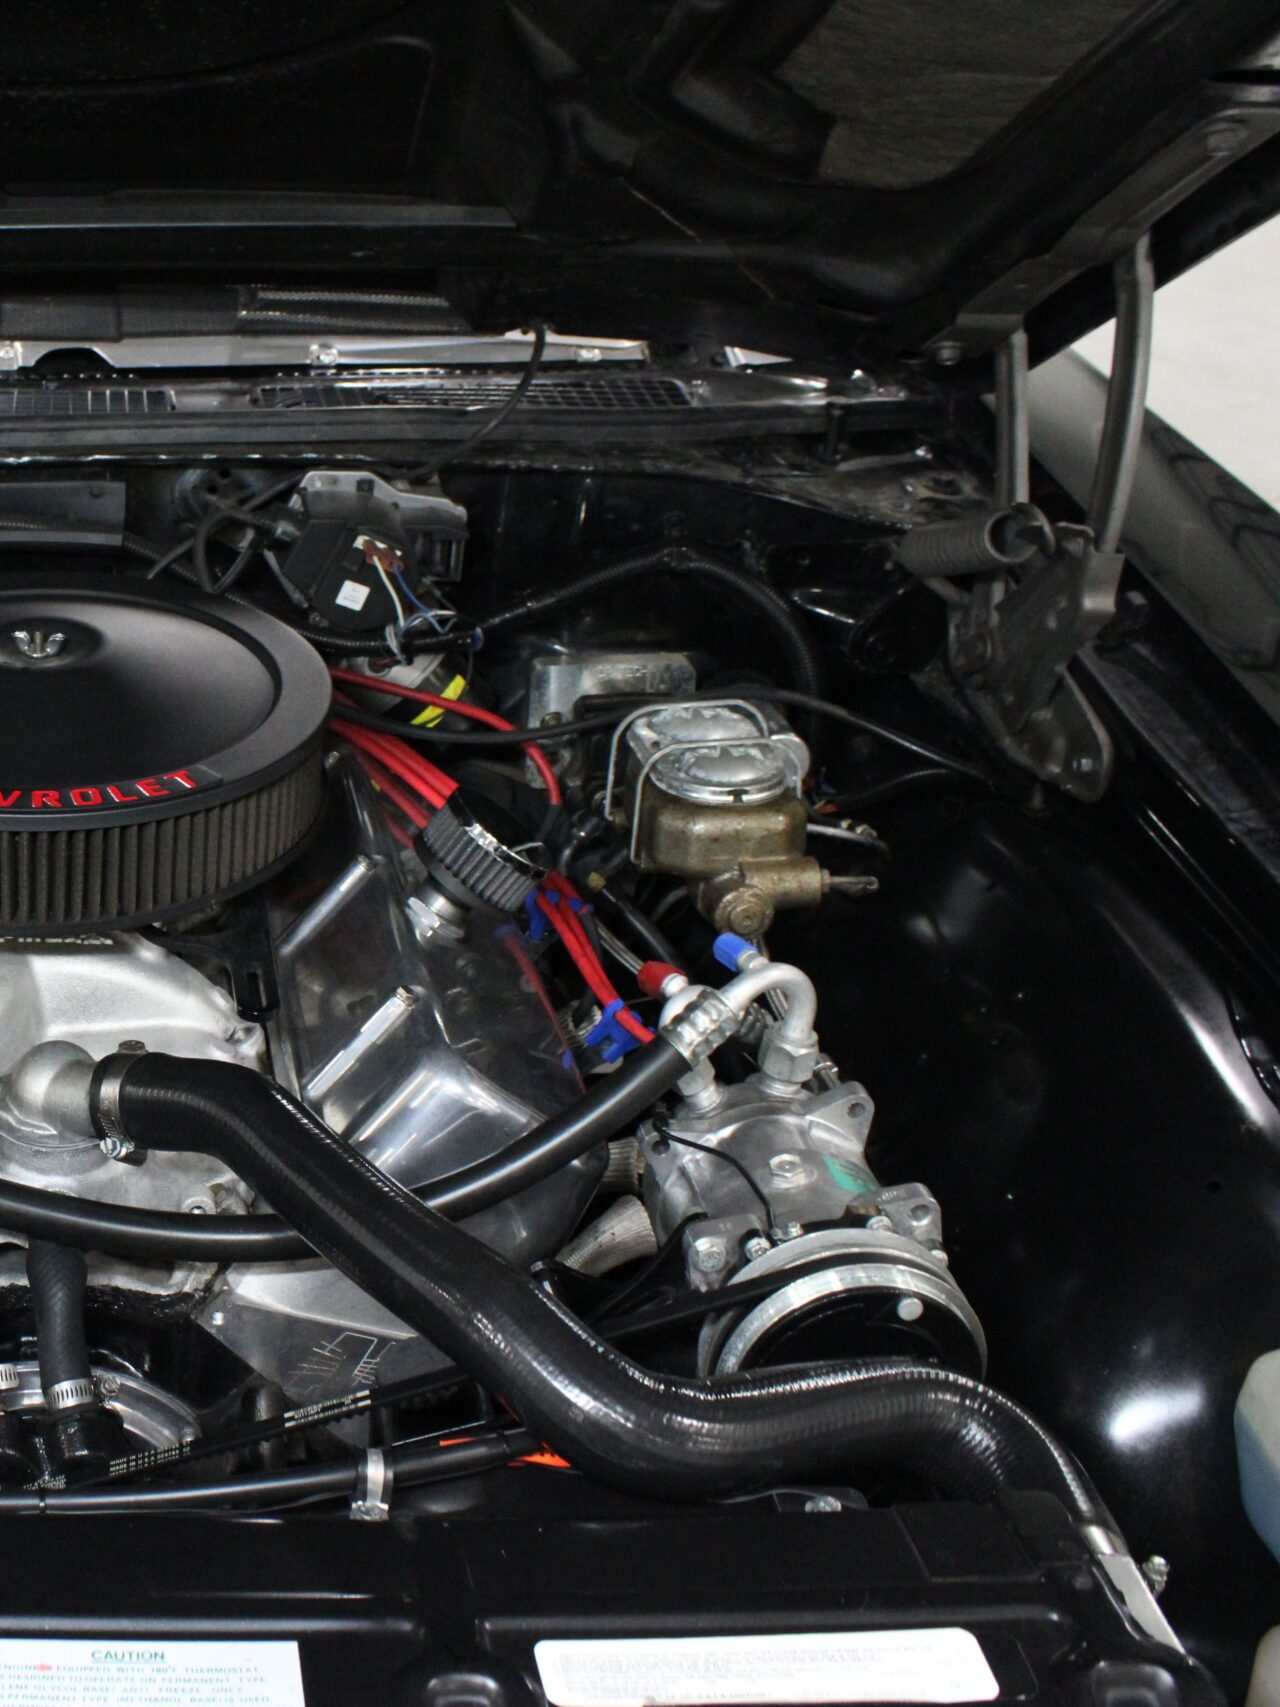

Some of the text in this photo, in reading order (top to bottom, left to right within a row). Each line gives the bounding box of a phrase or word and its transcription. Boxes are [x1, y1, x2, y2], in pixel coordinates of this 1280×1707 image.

[89, 1650, 166, 1662] CAUTION
[115, 1665, 145, 1673] WITH
[184, 1666, 259, 1674] THERMOSTAT
[160, 1676, 230, 1685] PERMANENT
